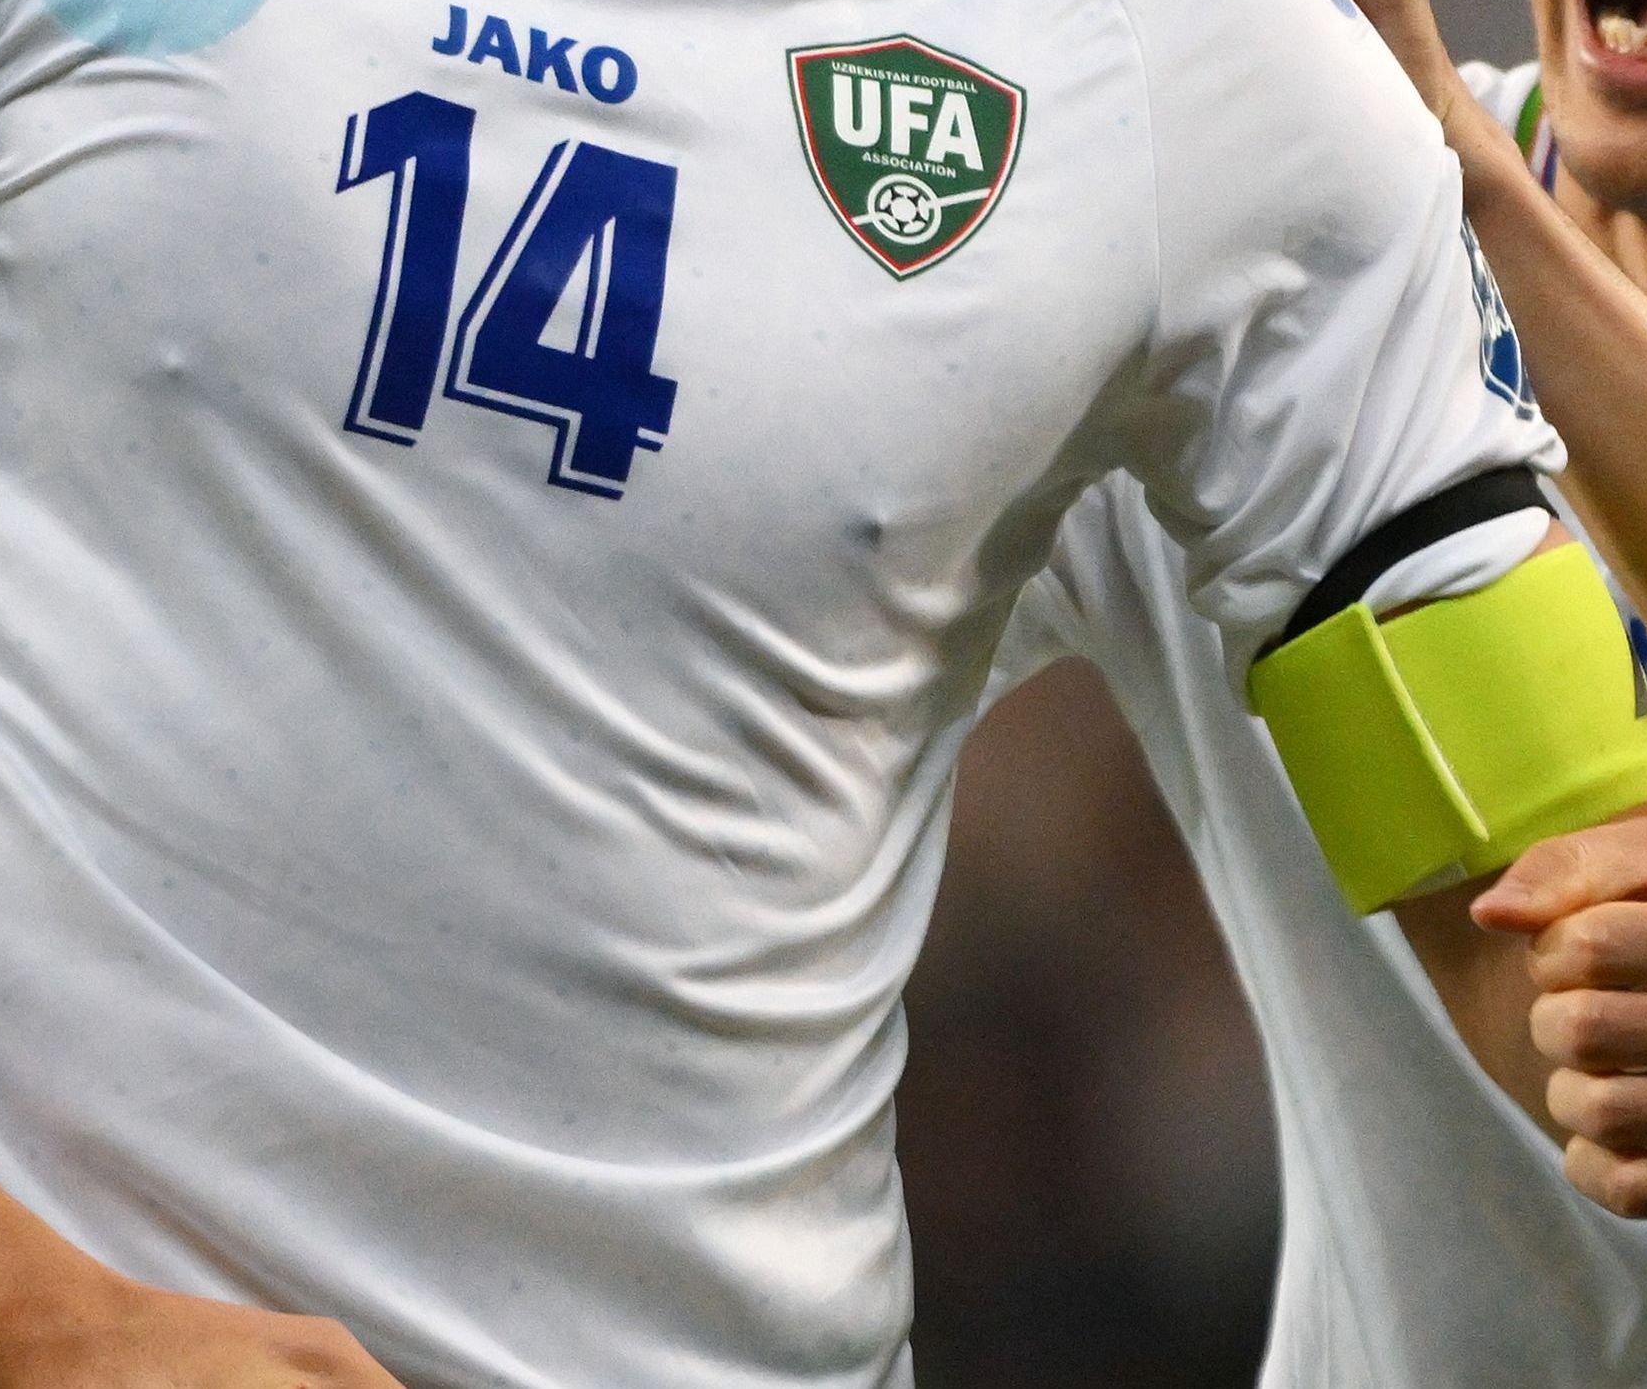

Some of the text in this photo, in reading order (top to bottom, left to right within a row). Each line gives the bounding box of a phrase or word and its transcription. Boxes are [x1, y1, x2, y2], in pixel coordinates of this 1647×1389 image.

[431, 3, 639, 105] JAKO
[831, 61, 979, 94] UZBEKISTAN FOOTBALL
[832, 74, 984, 171] UFA
[862, 151, 957, 179] ASSOCIATION
[335, 89, 679, 502] 14
